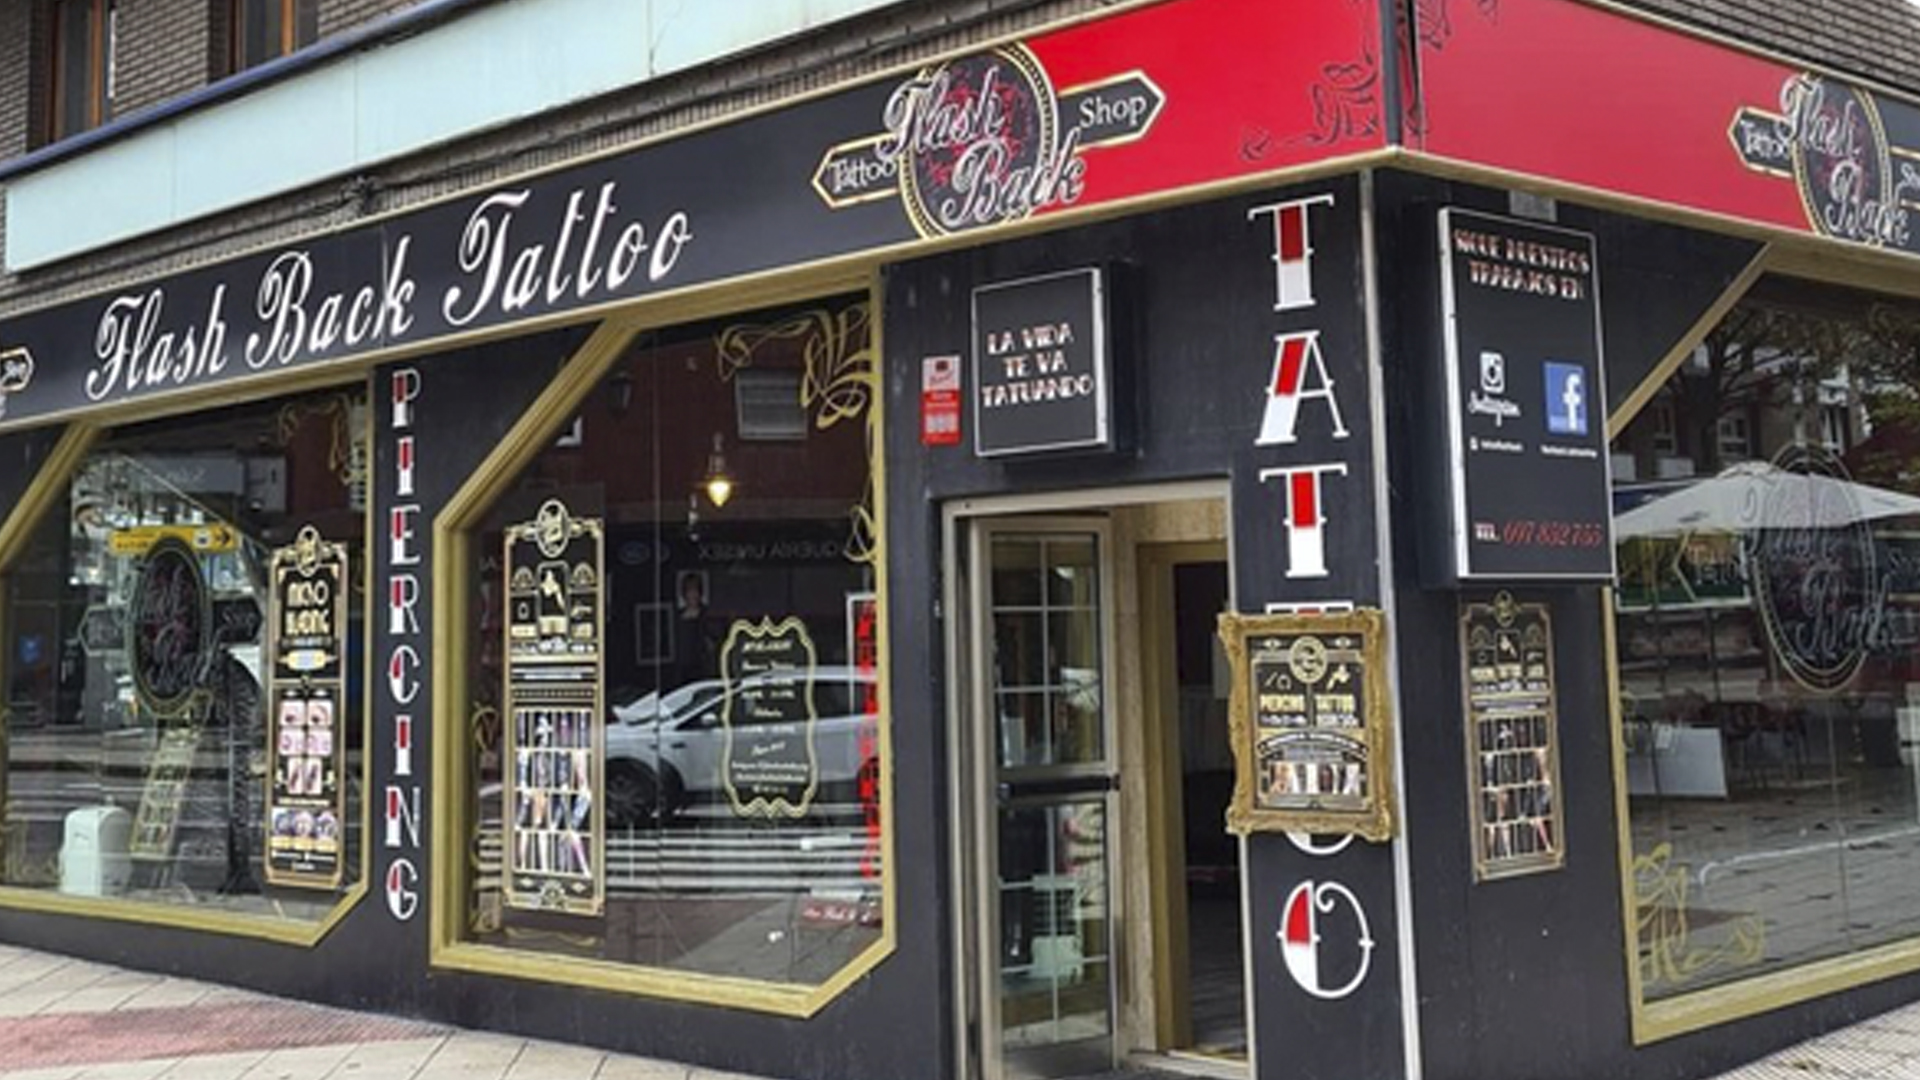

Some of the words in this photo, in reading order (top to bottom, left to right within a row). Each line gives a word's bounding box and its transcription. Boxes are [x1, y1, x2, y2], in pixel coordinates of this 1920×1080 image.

[875, 62, 1005, 161] Flash
[1079, 96, 1147, 129] Shop
[829, 157, 896, 193] Tattoo
[941, 126, 1086, 226] Back
[86, 284, 226, 400] Flash
[245, 236, 412, 368] Back
[443, 182, 692, 325] Tattoo
[987, 331, 1014, 354] LA
[1021, 323, 1073, 349] VIDA
[1004, 355, 1030, 378] TE
[1036, 350, 1067, 374] VA
[982, 373, 1093, 407] TATUANDO
[1248, 195, 1374, 998] TATO
[386, 369, 421, 920] PIERCING
